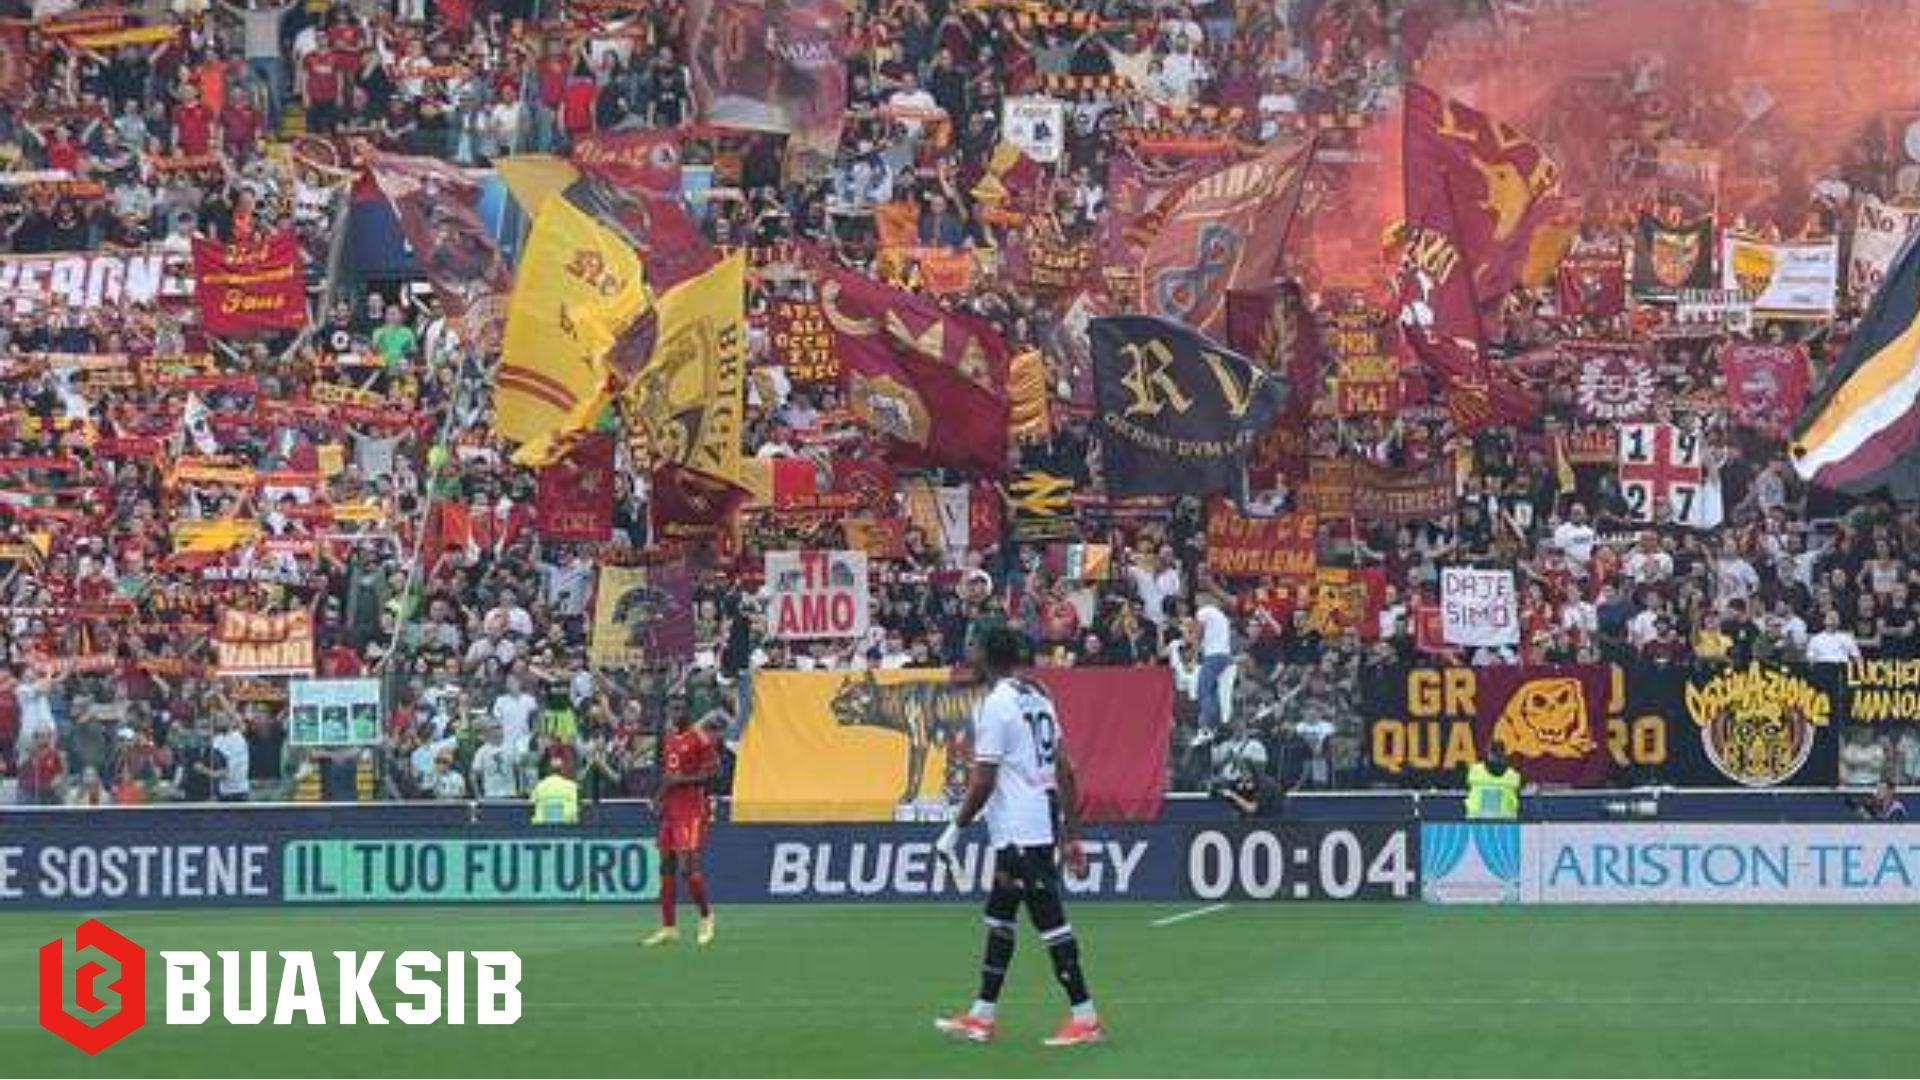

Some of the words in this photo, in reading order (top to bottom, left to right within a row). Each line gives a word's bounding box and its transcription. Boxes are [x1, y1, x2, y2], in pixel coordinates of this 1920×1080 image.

[801, 547, 829, 587] TI
[1446, 569, 1510, 599] DAJE
[777, 592, 856, 634] AMO
[41, 845, 269, 896] SOSTIENE
[294, 844, 336, 894] IL
[355, 844, 445, 893] TUO
[463, 843, 647, 894] FUTURO
[1189, 829, 1415, 900] 00:04
